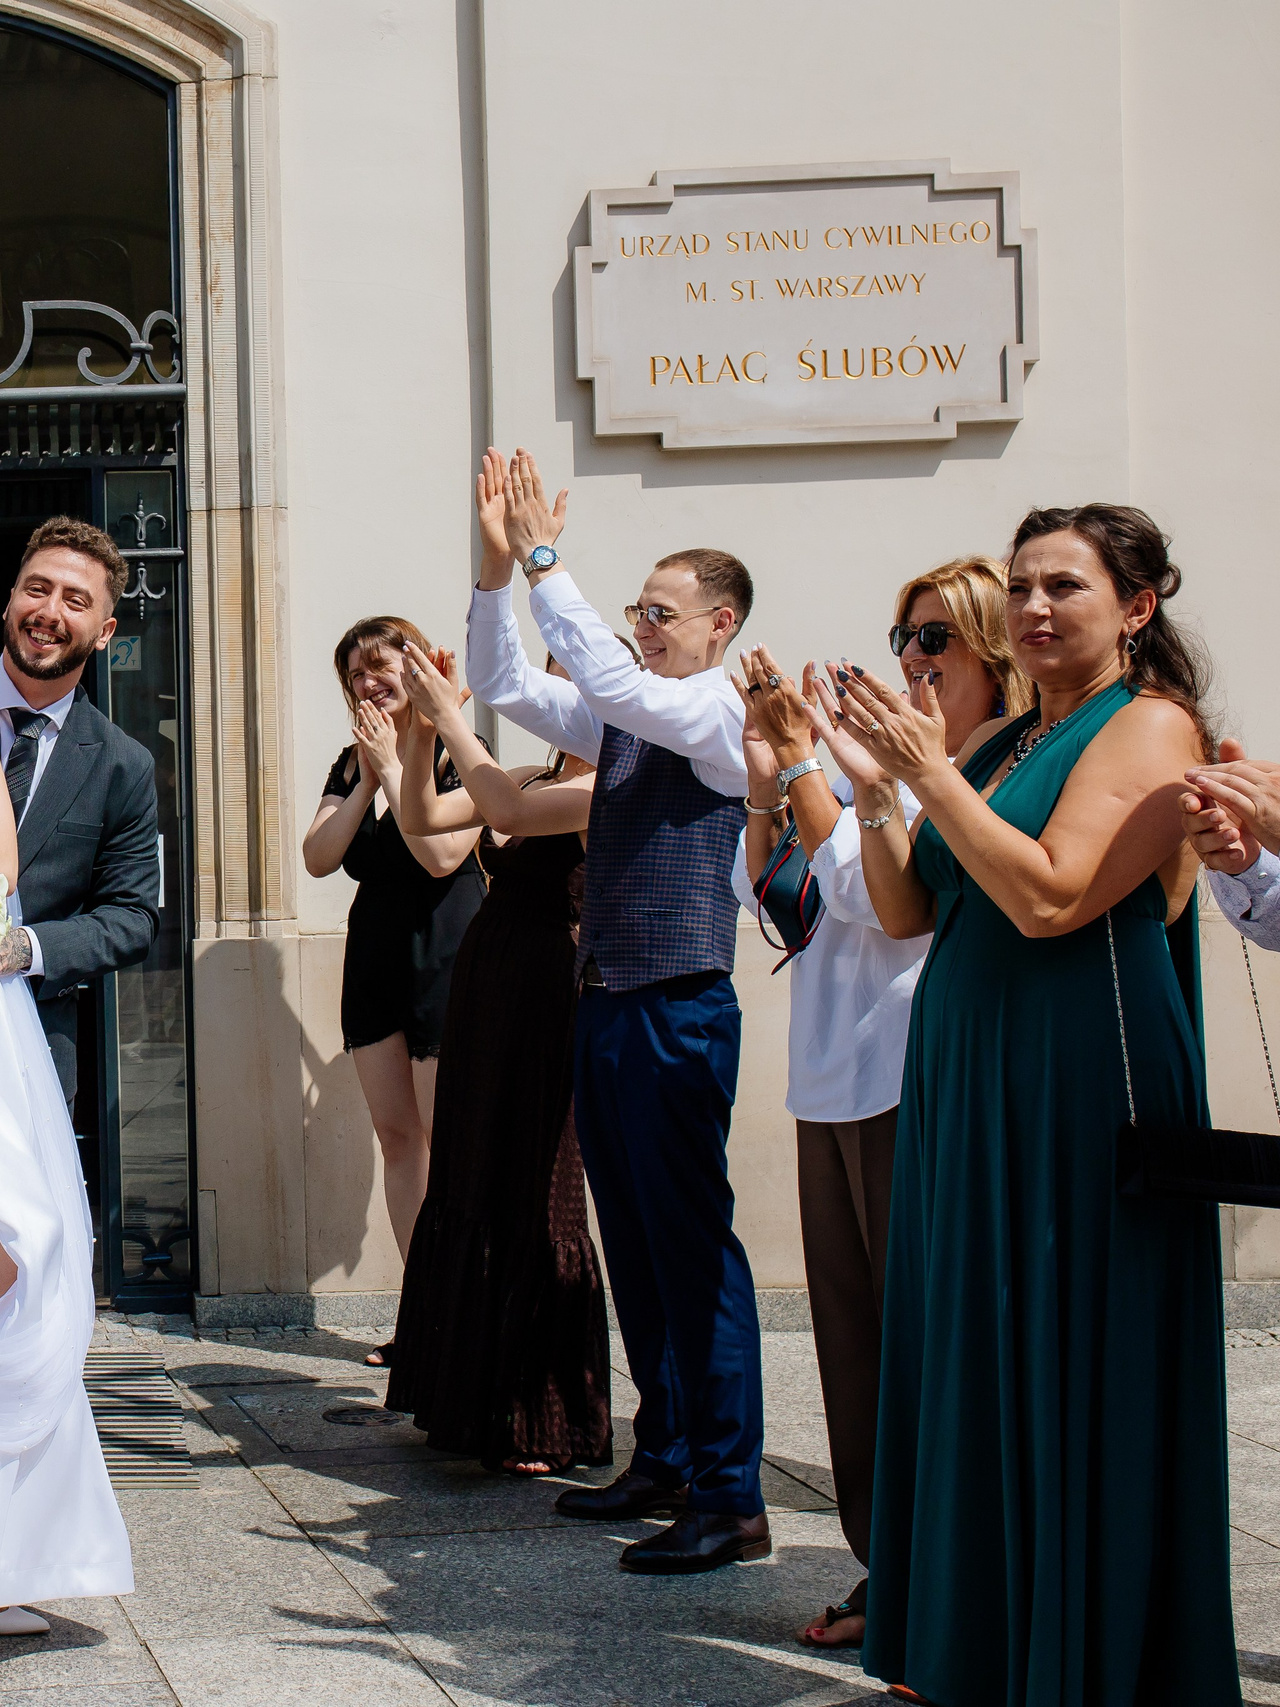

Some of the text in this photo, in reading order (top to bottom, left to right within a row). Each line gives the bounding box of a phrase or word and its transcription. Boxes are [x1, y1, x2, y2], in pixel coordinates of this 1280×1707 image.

[620, 219, 992, 261] URZĄD STANU CYWILNEGO
[685, 272, 927, 303] M. ST. WARSZAWY
[649, 334, 967, 388] PAŁAC ŚLUBÓW
